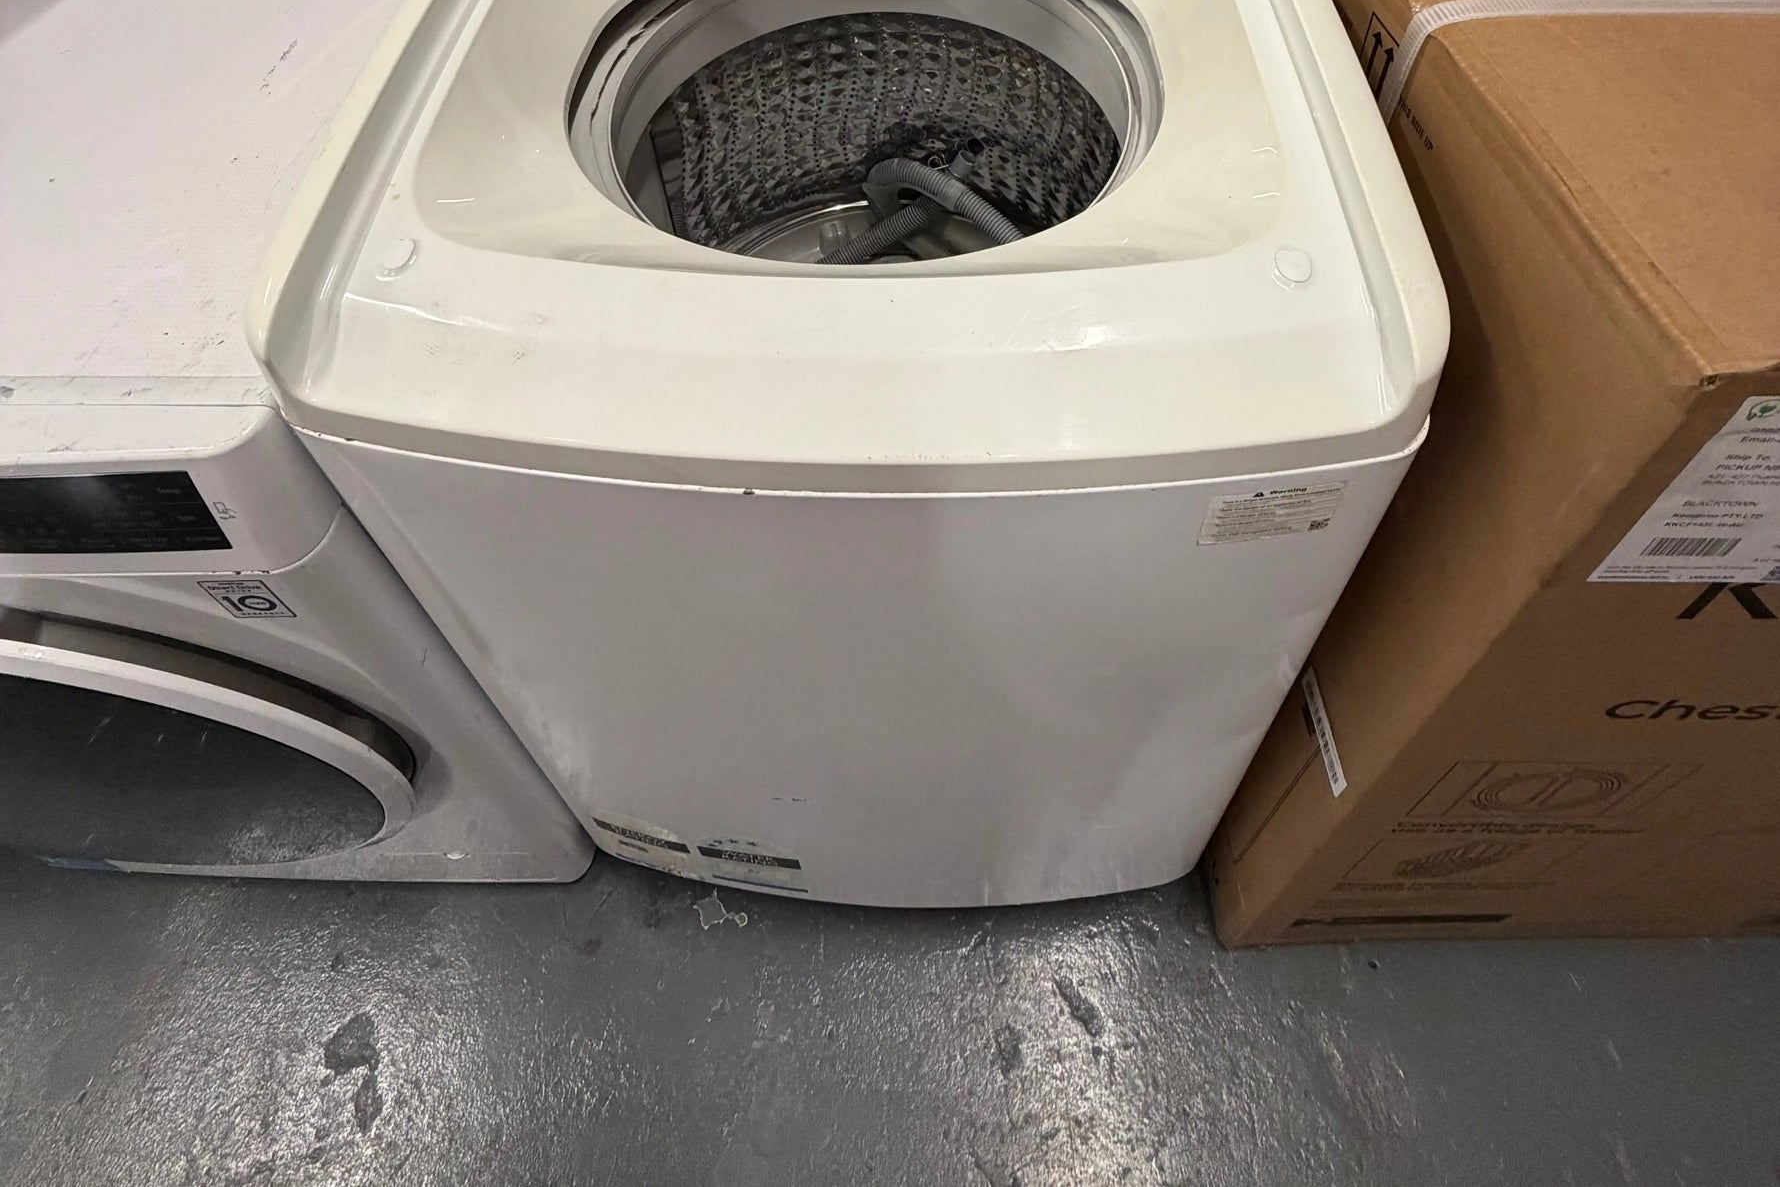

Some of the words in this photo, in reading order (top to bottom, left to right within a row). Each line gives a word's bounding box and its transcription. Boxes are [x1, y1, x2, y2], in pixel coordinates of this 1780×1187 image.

[1269, 487, 1308, 495] Warning
[221, 595, 278, 612] 10
[1605, 699, 1780, 720] Ches
